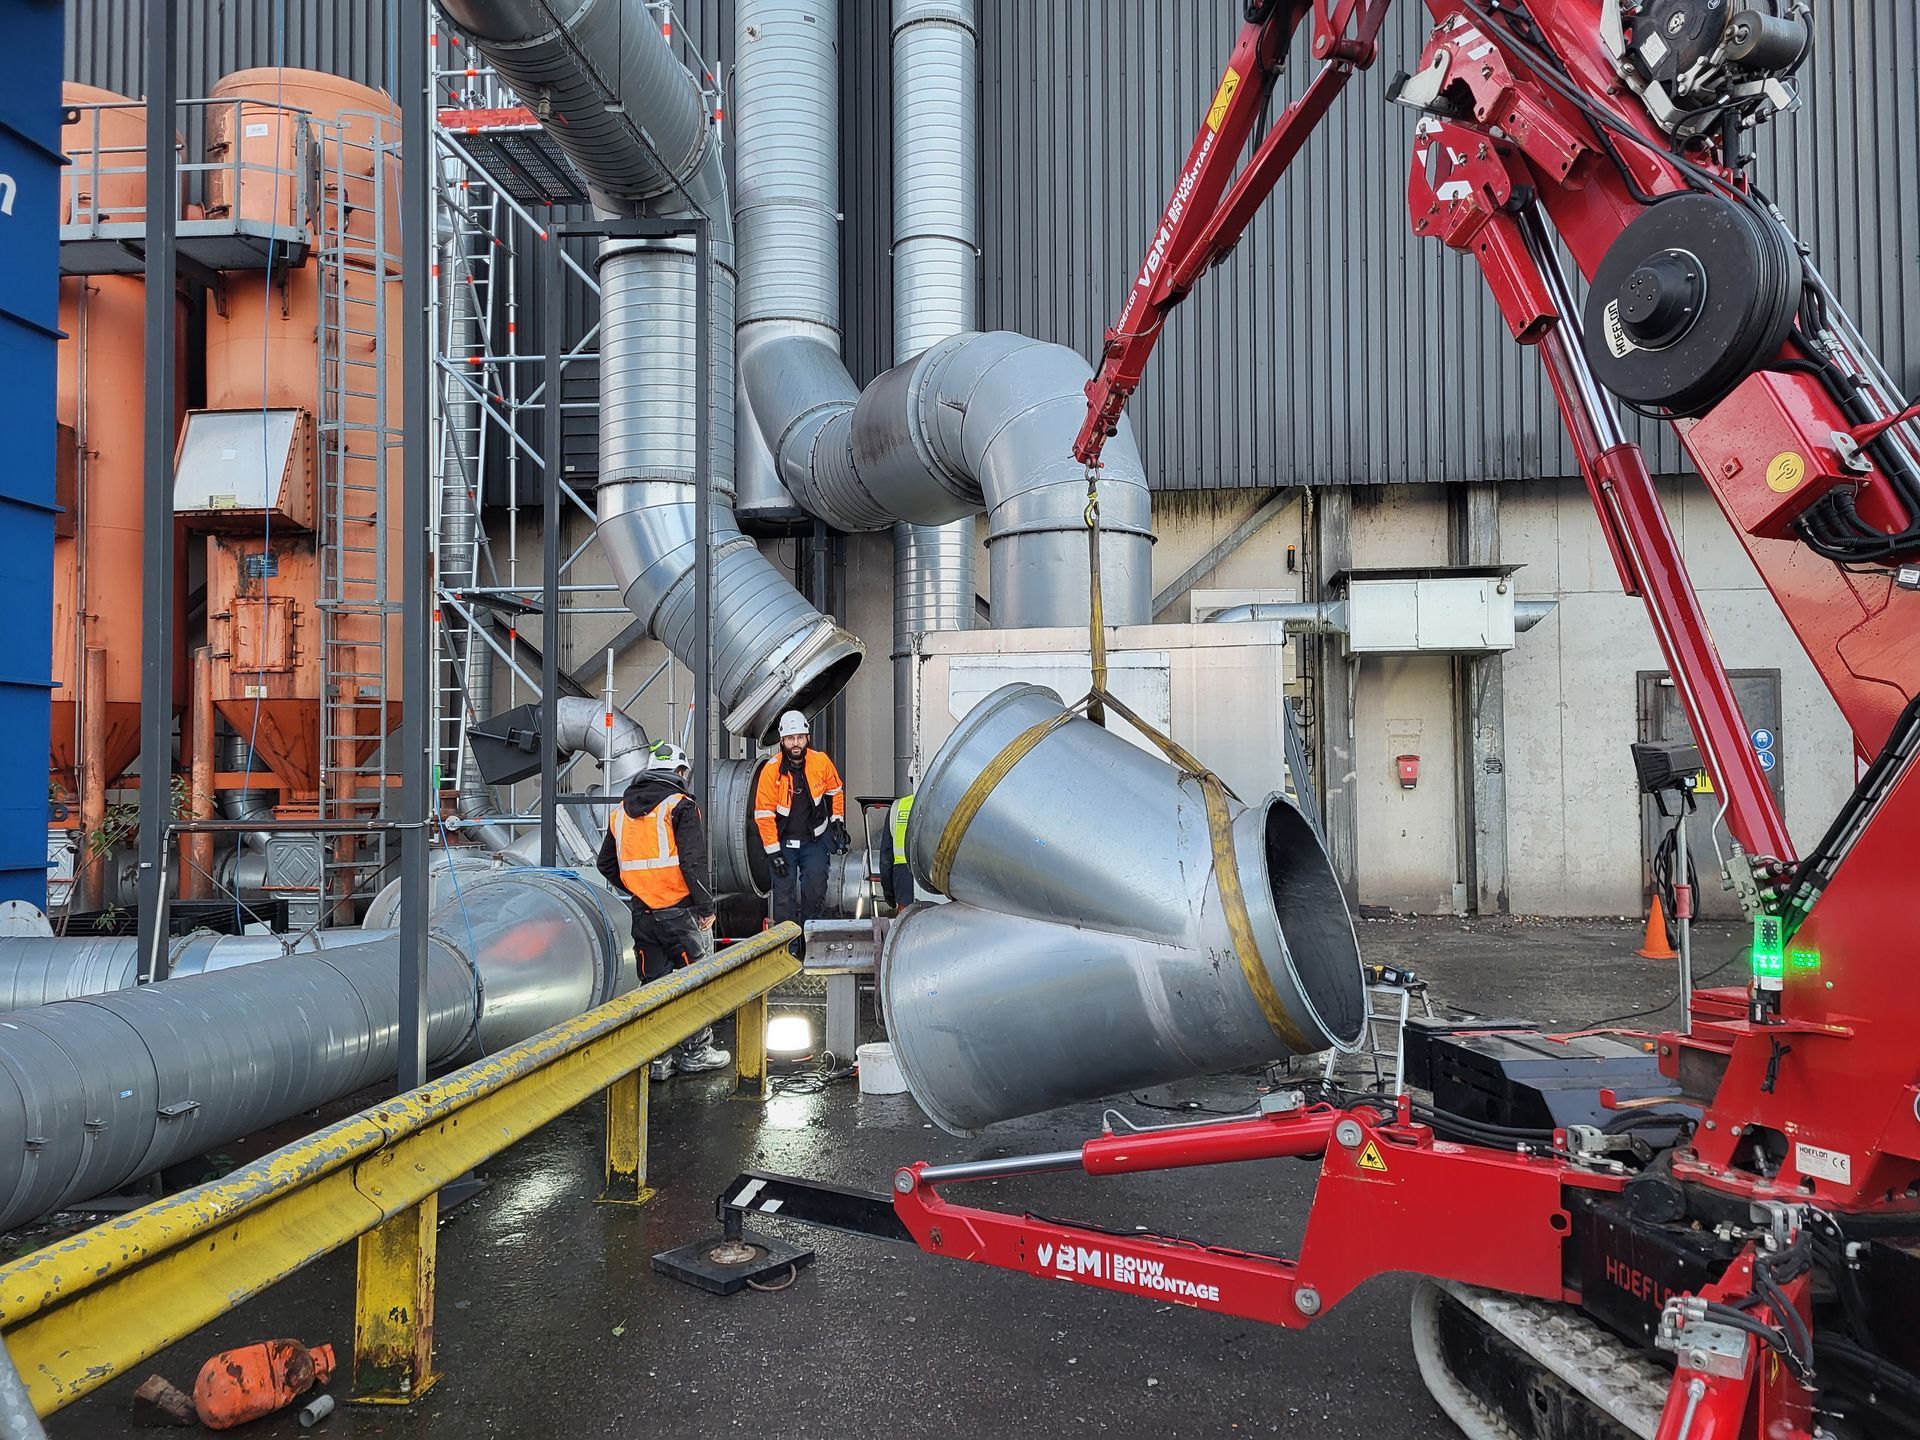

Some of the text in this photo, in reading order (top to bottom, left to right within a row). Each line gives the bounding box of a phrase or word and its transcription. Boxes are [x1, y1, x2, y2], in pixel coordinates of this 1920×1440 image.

[1168, 171, 1189, 216] BOUW
[1171, 130, 1215, 225] EN MONTAGE
[1138, 226, 1170, 287] VBM
[1607, 303, 1627, 356] HOEFLON
[1037, 1242, 1102, 1278] VBM
[1113, 1253, 1164, 1276] BOUW
[1606, 1254, 1678, 1311] HOEFL
[1114, 1268, 1220, 1302] EN MONTAGE
